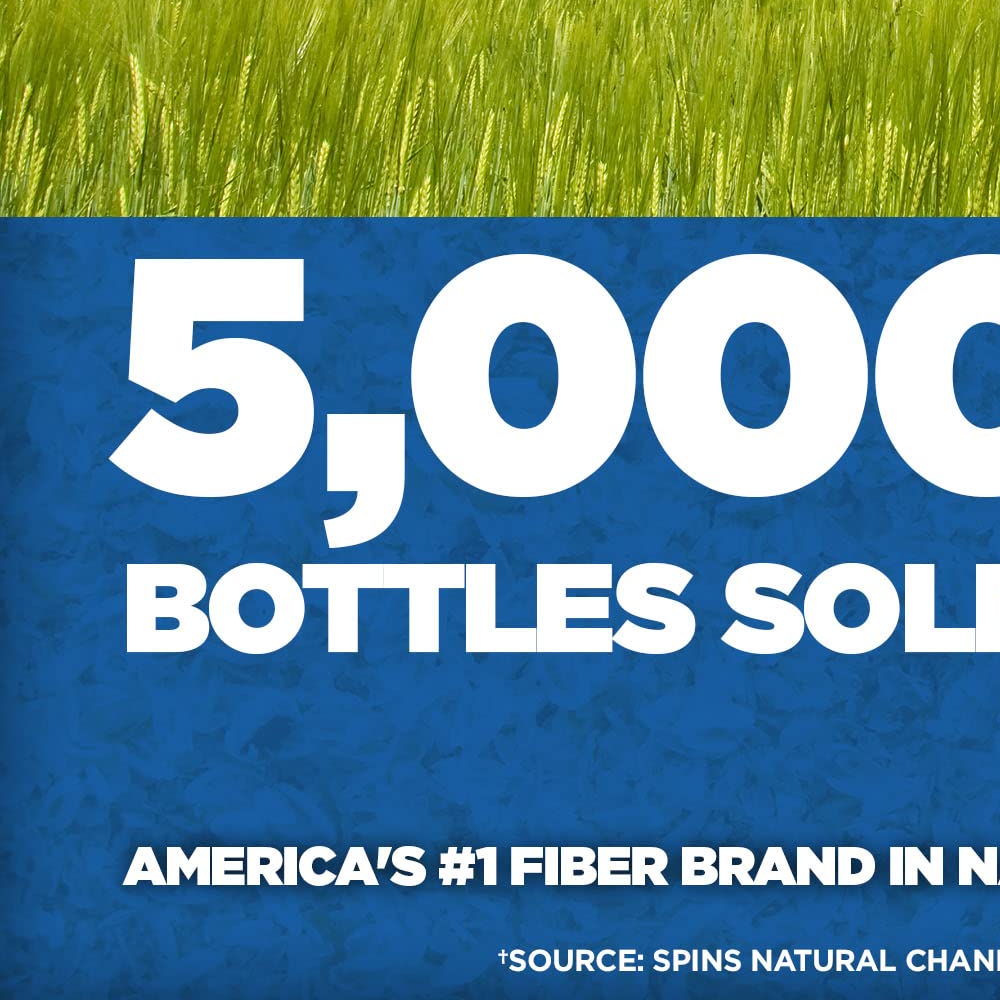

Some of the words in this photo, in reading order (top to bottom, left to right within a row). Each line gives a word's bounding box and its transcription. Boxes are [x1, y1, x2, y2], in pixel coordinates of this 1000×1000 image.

[126, 562, 696, 655] BOTTLES
[122, 845, 427, 887] AMERICA'S
[438, 846, 497, 886] #1
[510, 846, 669, 886] FIBER
[681, 846, 876, 886] BRAND
[889, 846, 944, 886] IN
[653, 949, 742, 972] SPINS
[752, 949, 897, 972] NATURAL
